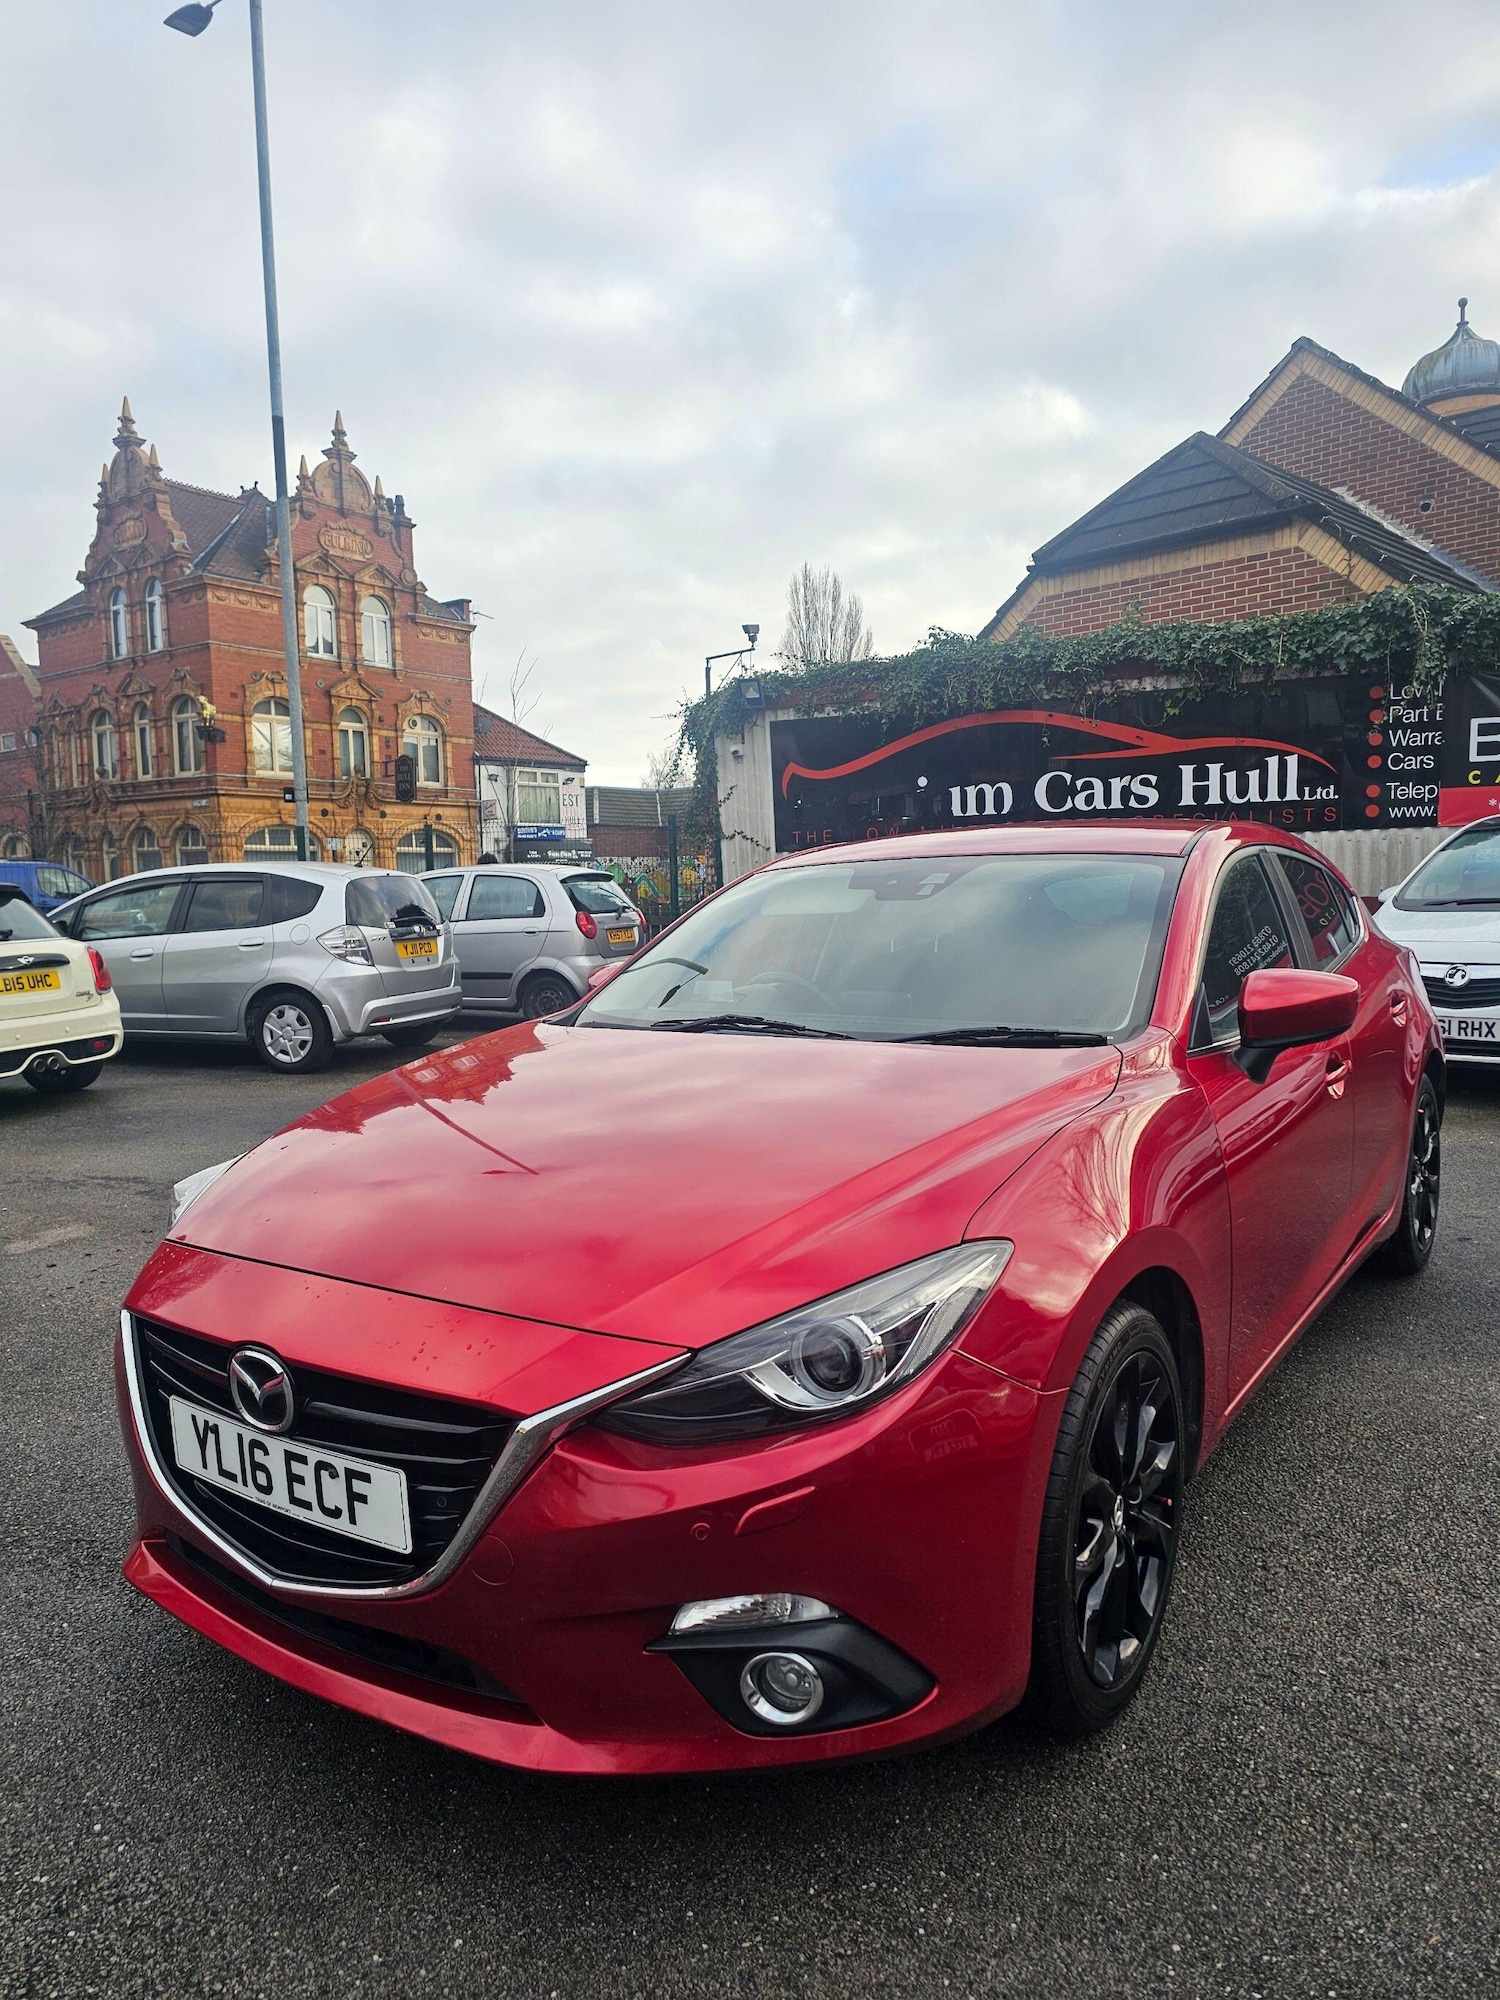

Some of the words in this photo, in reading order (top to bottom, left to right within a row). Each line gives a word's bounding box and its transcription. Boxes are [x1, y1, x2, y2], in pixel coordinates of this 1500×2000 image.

[1389, 705, 1429, 723] Part
[1387, 752, 1435, 770] Cars
[1034, 771, 1159, 812] Cars
[1178, 754, 1300, 807] Hull
[1304, 783, 1339, 801] Ltd.
[1386, 782, 1438, 802] Telep
[1388, 805, 1437, 818] www.
[792, 829, 832, 844] THE
[27, 974, 53, 989] UHC
[1458, 1020, 1496, 1039] RHX
[191, 1413, 274, 1497] YL16
[283, 1449, 372, 1526] ECF
